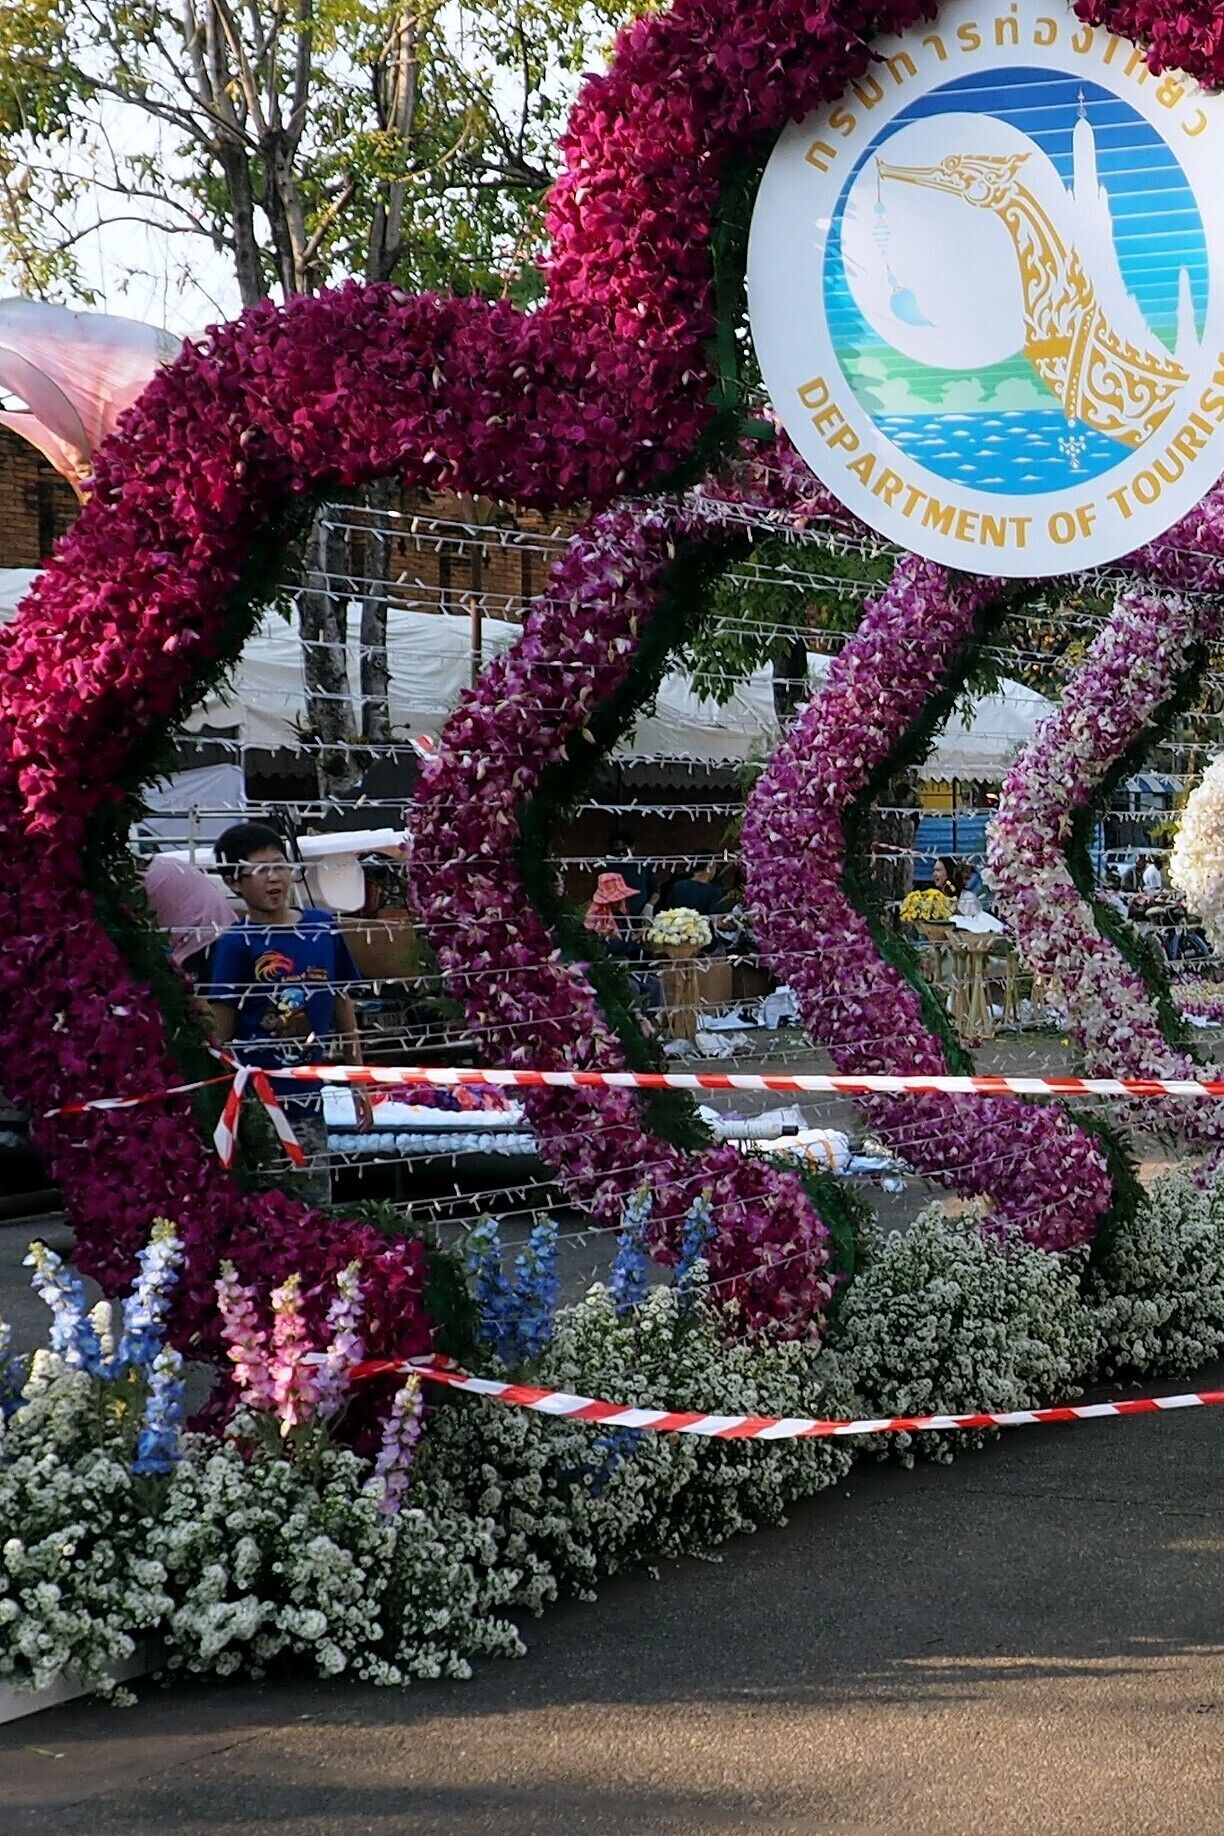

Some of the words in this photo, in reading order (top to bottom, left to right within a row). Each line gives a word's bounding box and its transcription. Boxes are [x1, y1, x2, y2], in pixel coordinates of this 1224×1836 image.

[804, 3, 1208, 172] กรมการท่องเยว
[798, 376, 1032, 549] DEPARTMENT
[1048, 503, 1098, 545] OF
